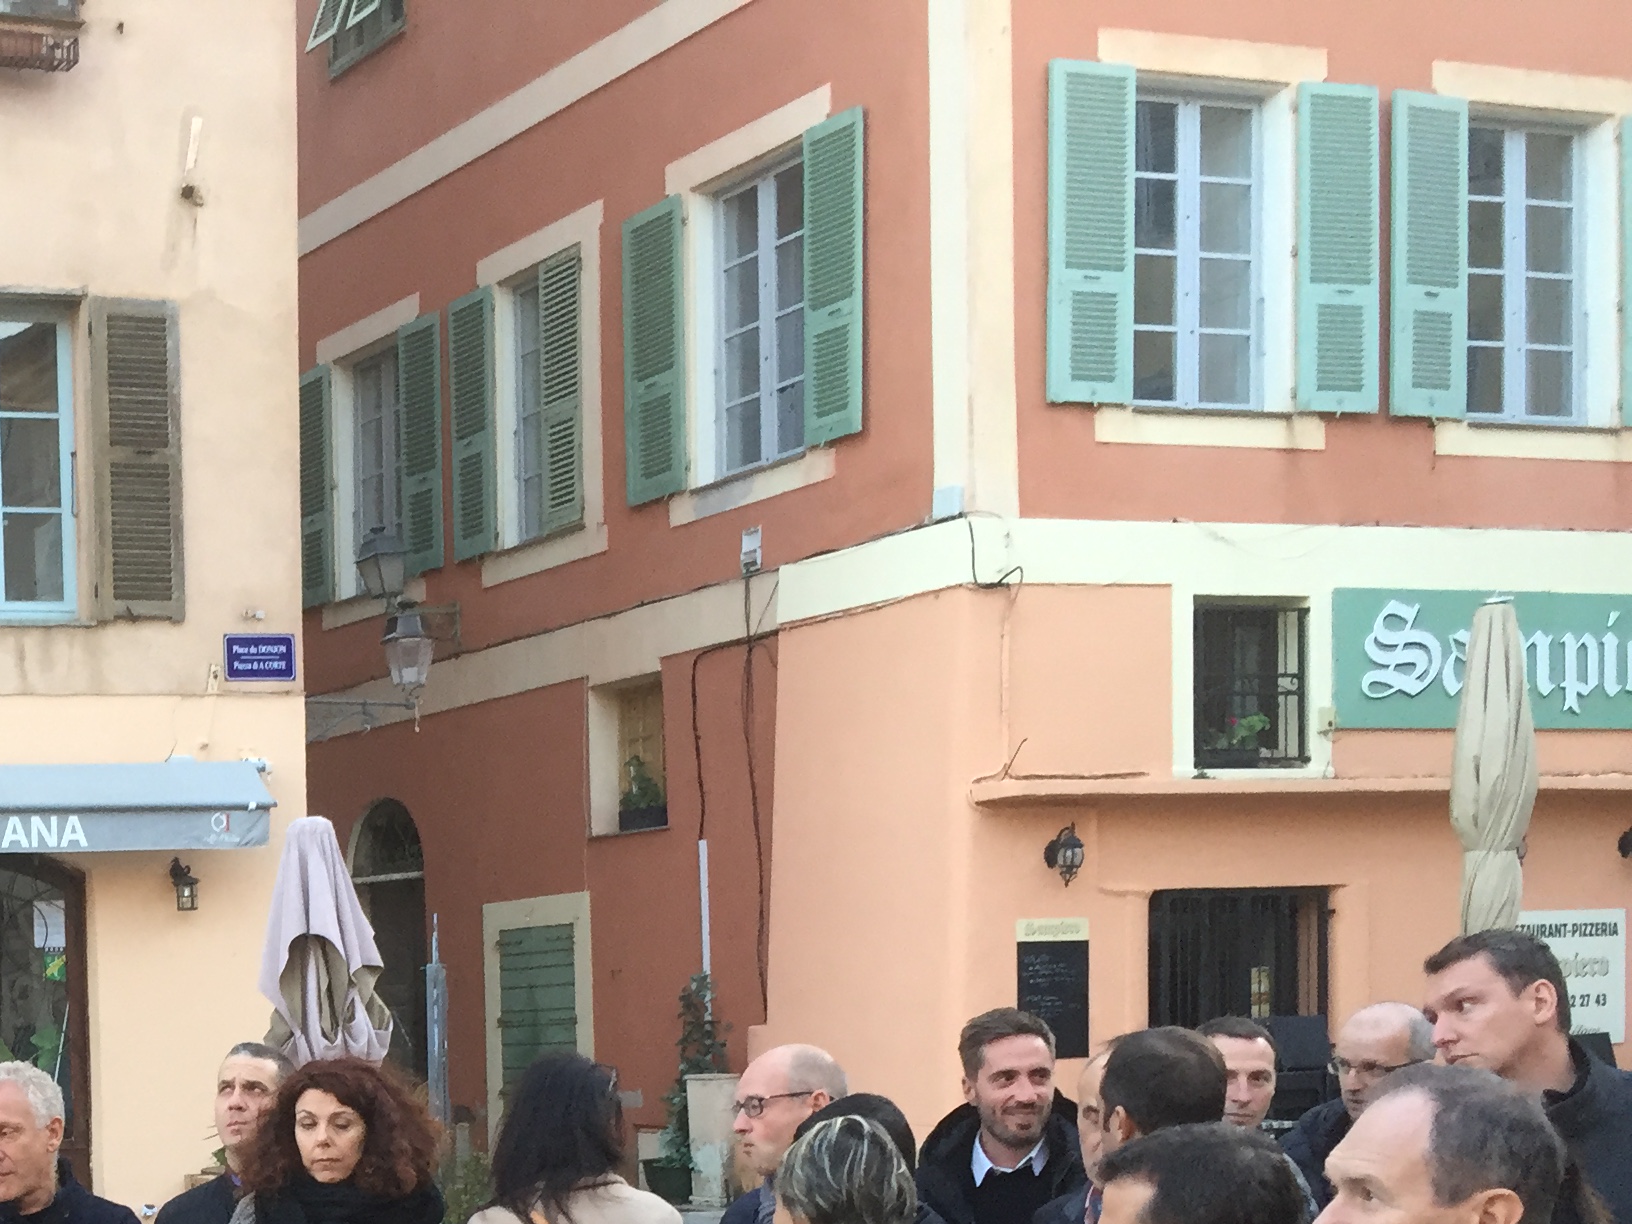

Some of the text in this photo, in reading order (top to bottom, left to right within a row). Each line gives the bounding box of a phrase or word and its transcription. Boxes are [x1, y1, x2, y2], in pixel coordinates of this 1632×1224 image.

[232, 645, 248, 654] Place
[1579, 993, 1591, 1007] 27
[1595, 993, 1607, 1007] 43
